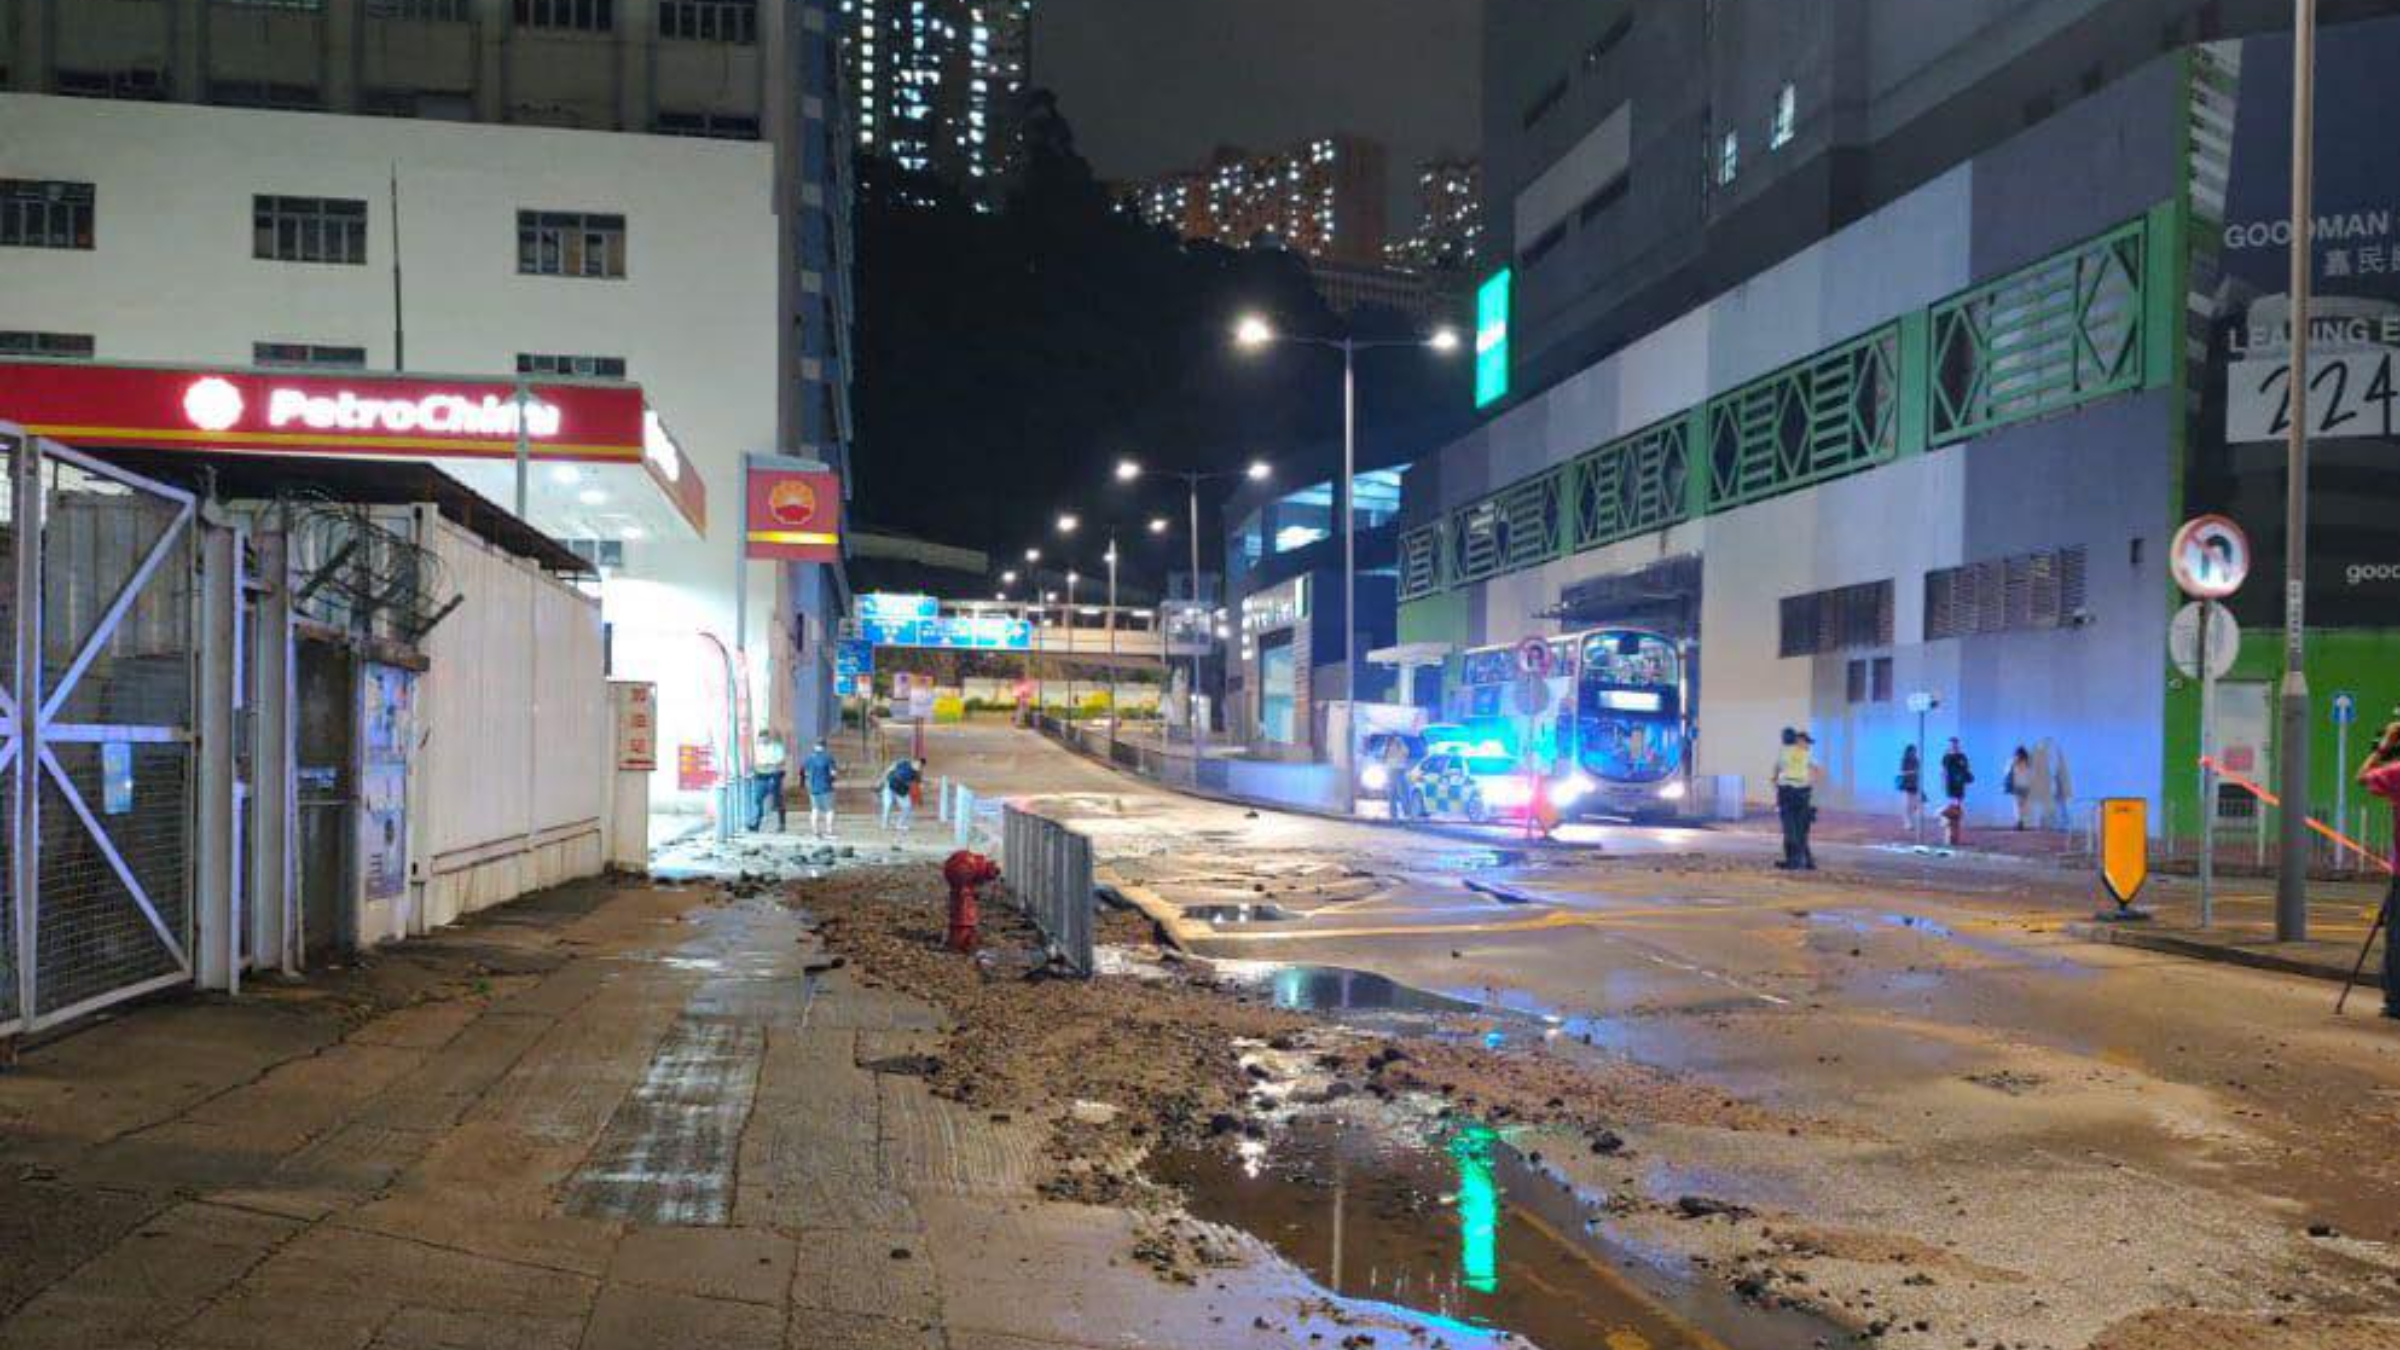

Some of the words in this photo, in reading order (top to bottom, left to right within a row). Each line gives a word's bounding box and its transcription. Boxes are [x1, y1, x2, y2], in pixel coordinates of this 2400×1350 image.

[2223, 211, 2389, 249] GOOMAN
[2229, 317, 2368, 352] LEAING
[267, 388, 562, 438] PetroChina
